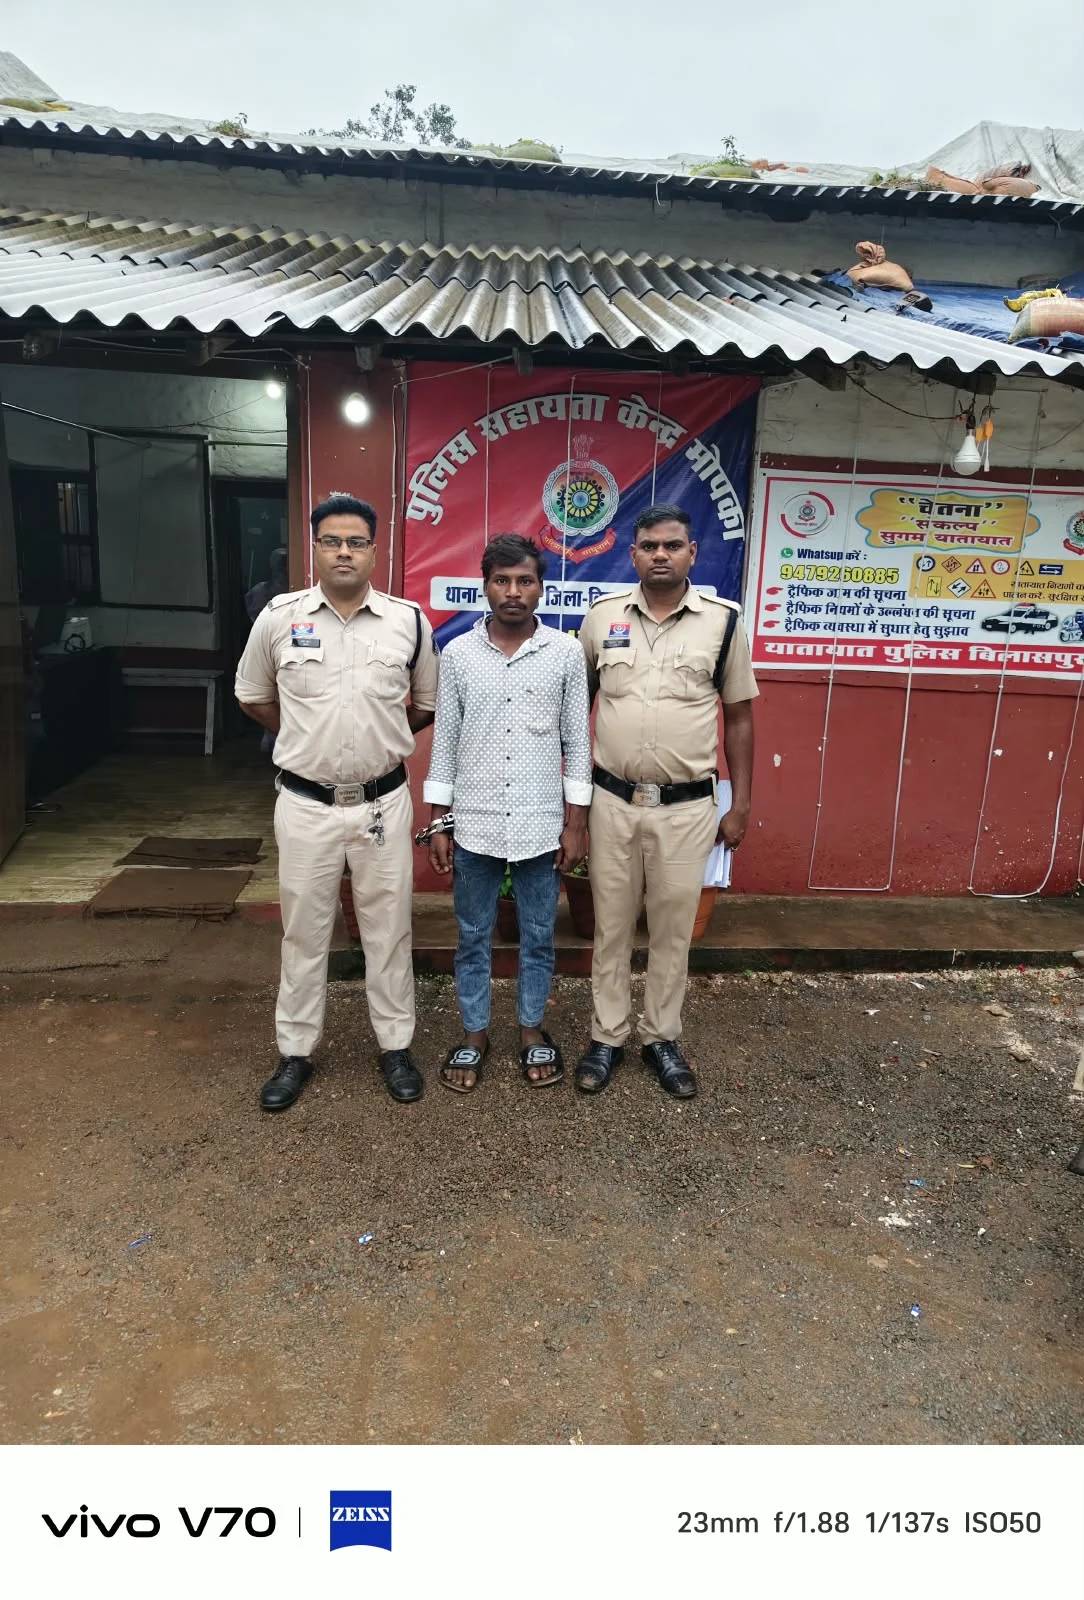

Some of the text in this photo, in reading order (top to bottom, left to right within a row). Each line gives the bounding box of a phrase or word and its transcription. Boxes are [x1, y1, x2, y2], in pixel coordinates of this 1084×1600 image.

[406, 393, 745, 542] पुलिस सहायता केन्द्र मोपका
[880, 531, 1013, 546] सुगम यातायात
[797, 548, 844, 561] Whatsup
[780, 564, 900, 584] 9479260885
[787, 584, 908, 603] ट्रैफिक जम की सूचना
[785, 600, 823, 616] ट्रैफिक
[862, 603, 876, 616] के
[922, 605, 940, 619] की
[942, 608, 977, 622] सूचना
[784, 617, 971, 639] ट्रैफिक व्यवस्था में सुधार हेतु सुझाव
[764, 642, 878, 658] यातायात
[882, 643, 963, 664] पुलिस
